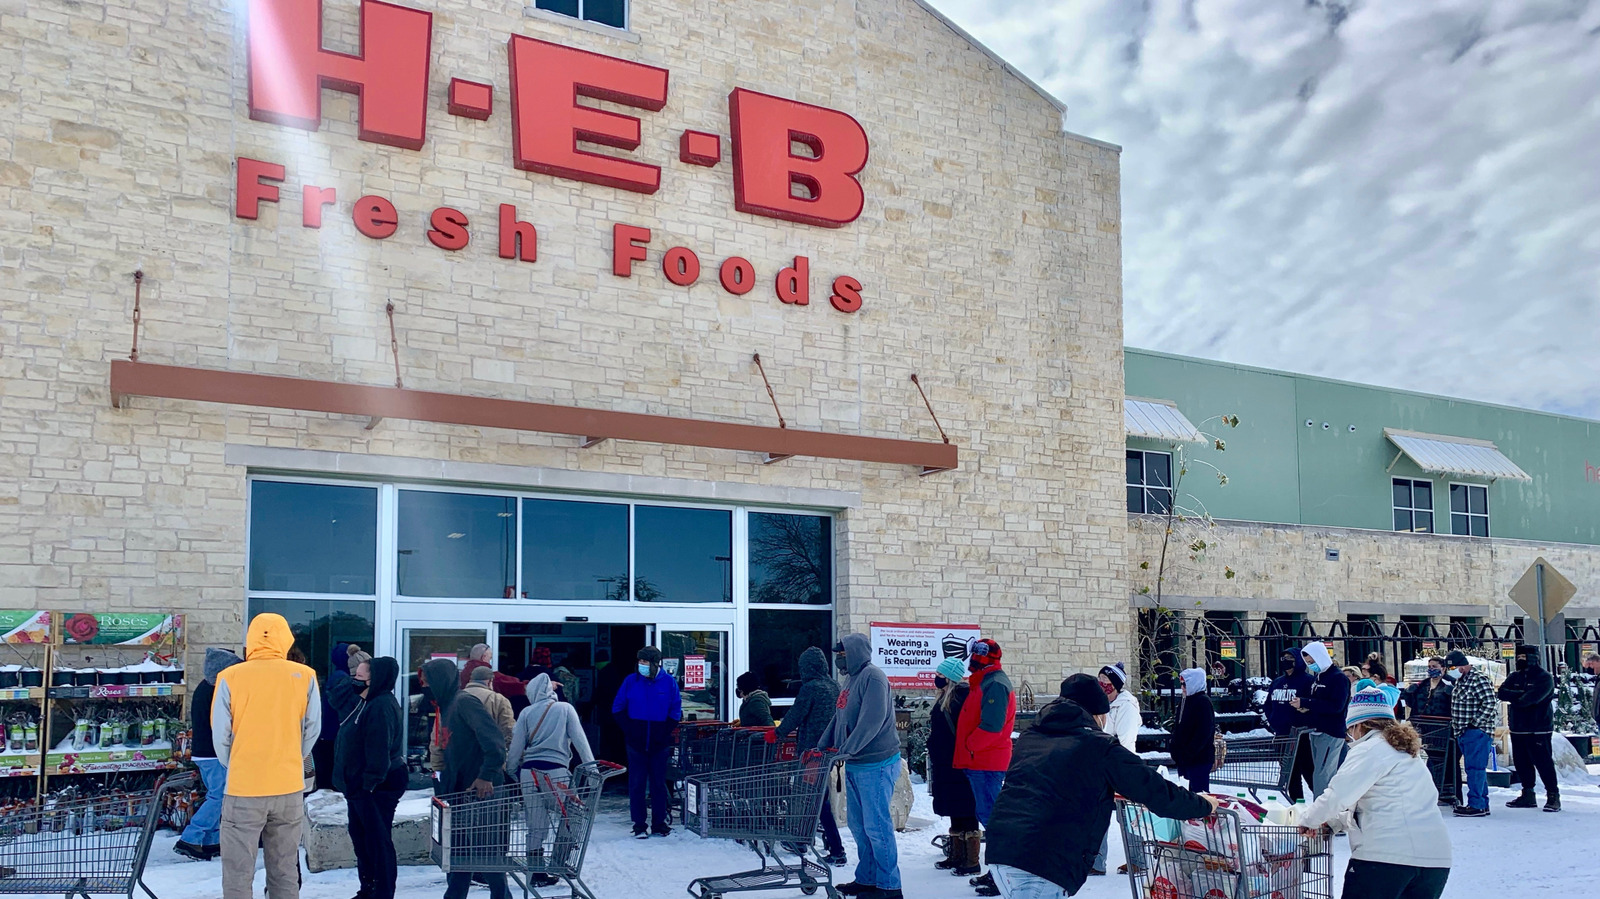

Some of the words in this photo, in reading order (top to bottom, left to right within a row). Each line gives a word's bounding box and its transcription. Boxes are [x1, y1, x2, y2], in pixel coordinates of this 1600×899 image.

[236, 157, 537, 262] Fresh
[612, 223, 863, 313] Foods
[100, 615, 149, 626] Roses
[887, 638, 922, 648] Wearing
[878, 648, 898, 656] Face
[900, 648, 936, 658] Covering
[894, 657, 931, 666] Required
[97, 687, 121, 696] Roses
